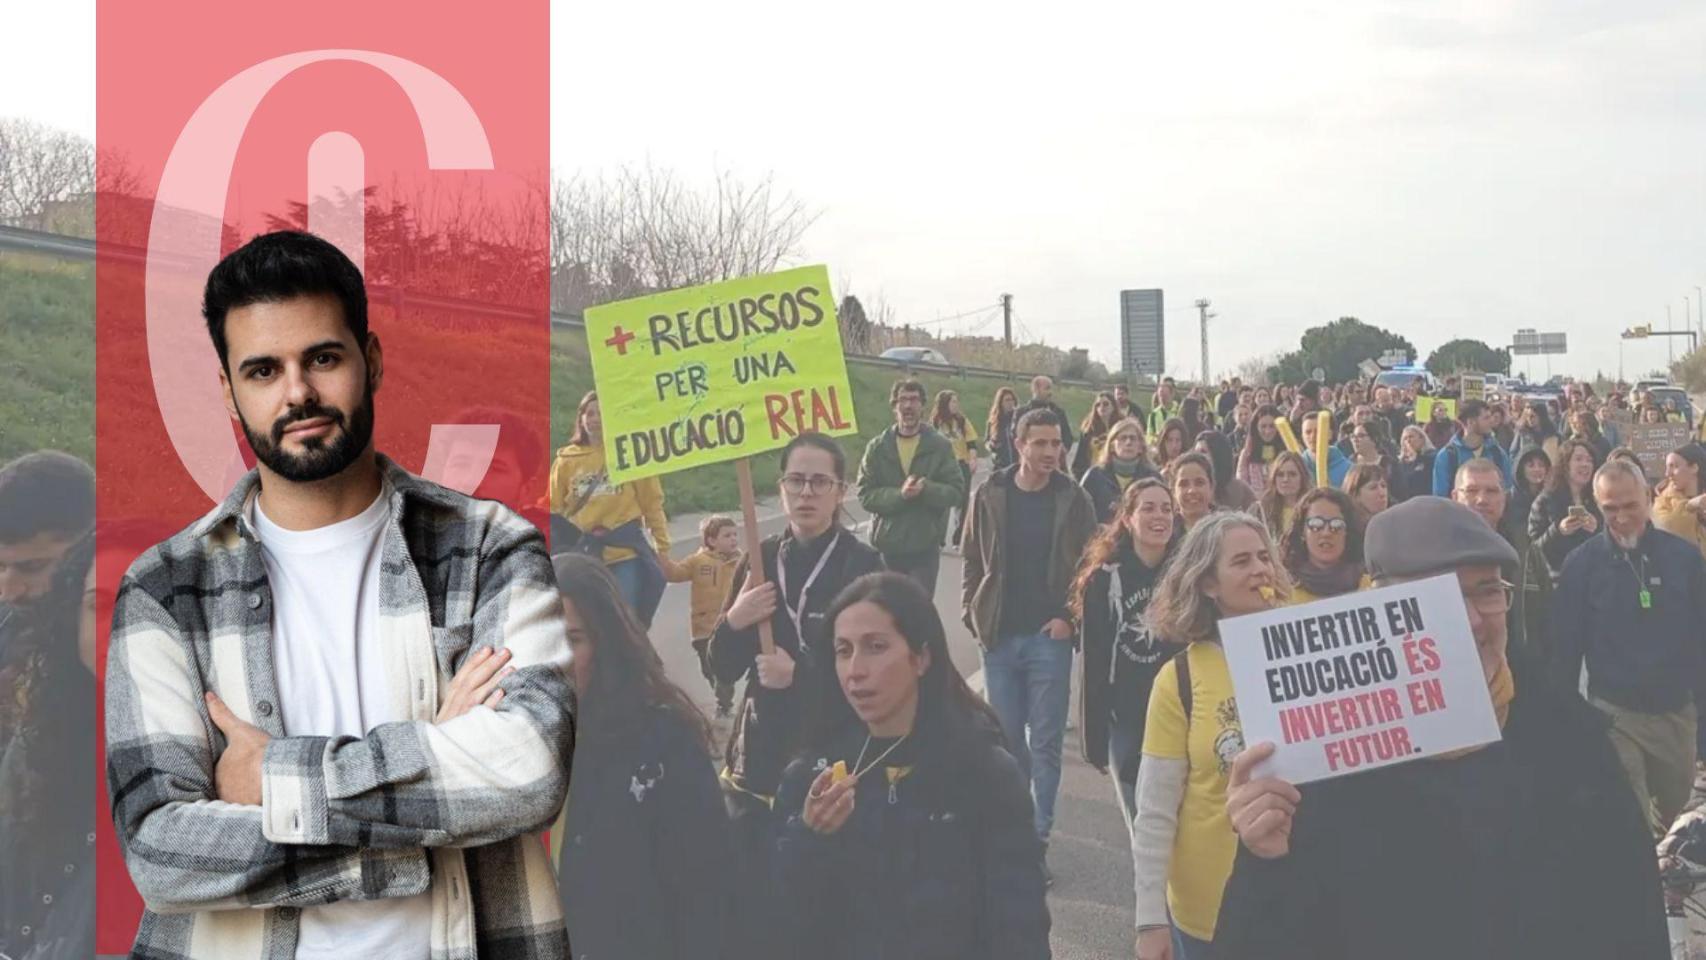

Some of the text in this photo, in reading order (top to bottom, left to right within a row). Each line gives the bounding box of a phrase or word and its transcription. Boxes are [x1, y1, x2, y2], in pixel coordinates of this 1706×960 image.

[648, 286, 824, 355] RECURSOS
[655, 350, 796, 401] PER UNA
[764, 385, 851, 440] REAL
[1261, 597, 1425, 661] INVERTIR EN
[1265, 631, 1442, 703] EDUCACIÓ ÉS
[1278, 688, 1404, 745] INVERTIR
[1406, 678, 1447, 716] EN
[1324, 726, 1422, 771] FUTUR.
